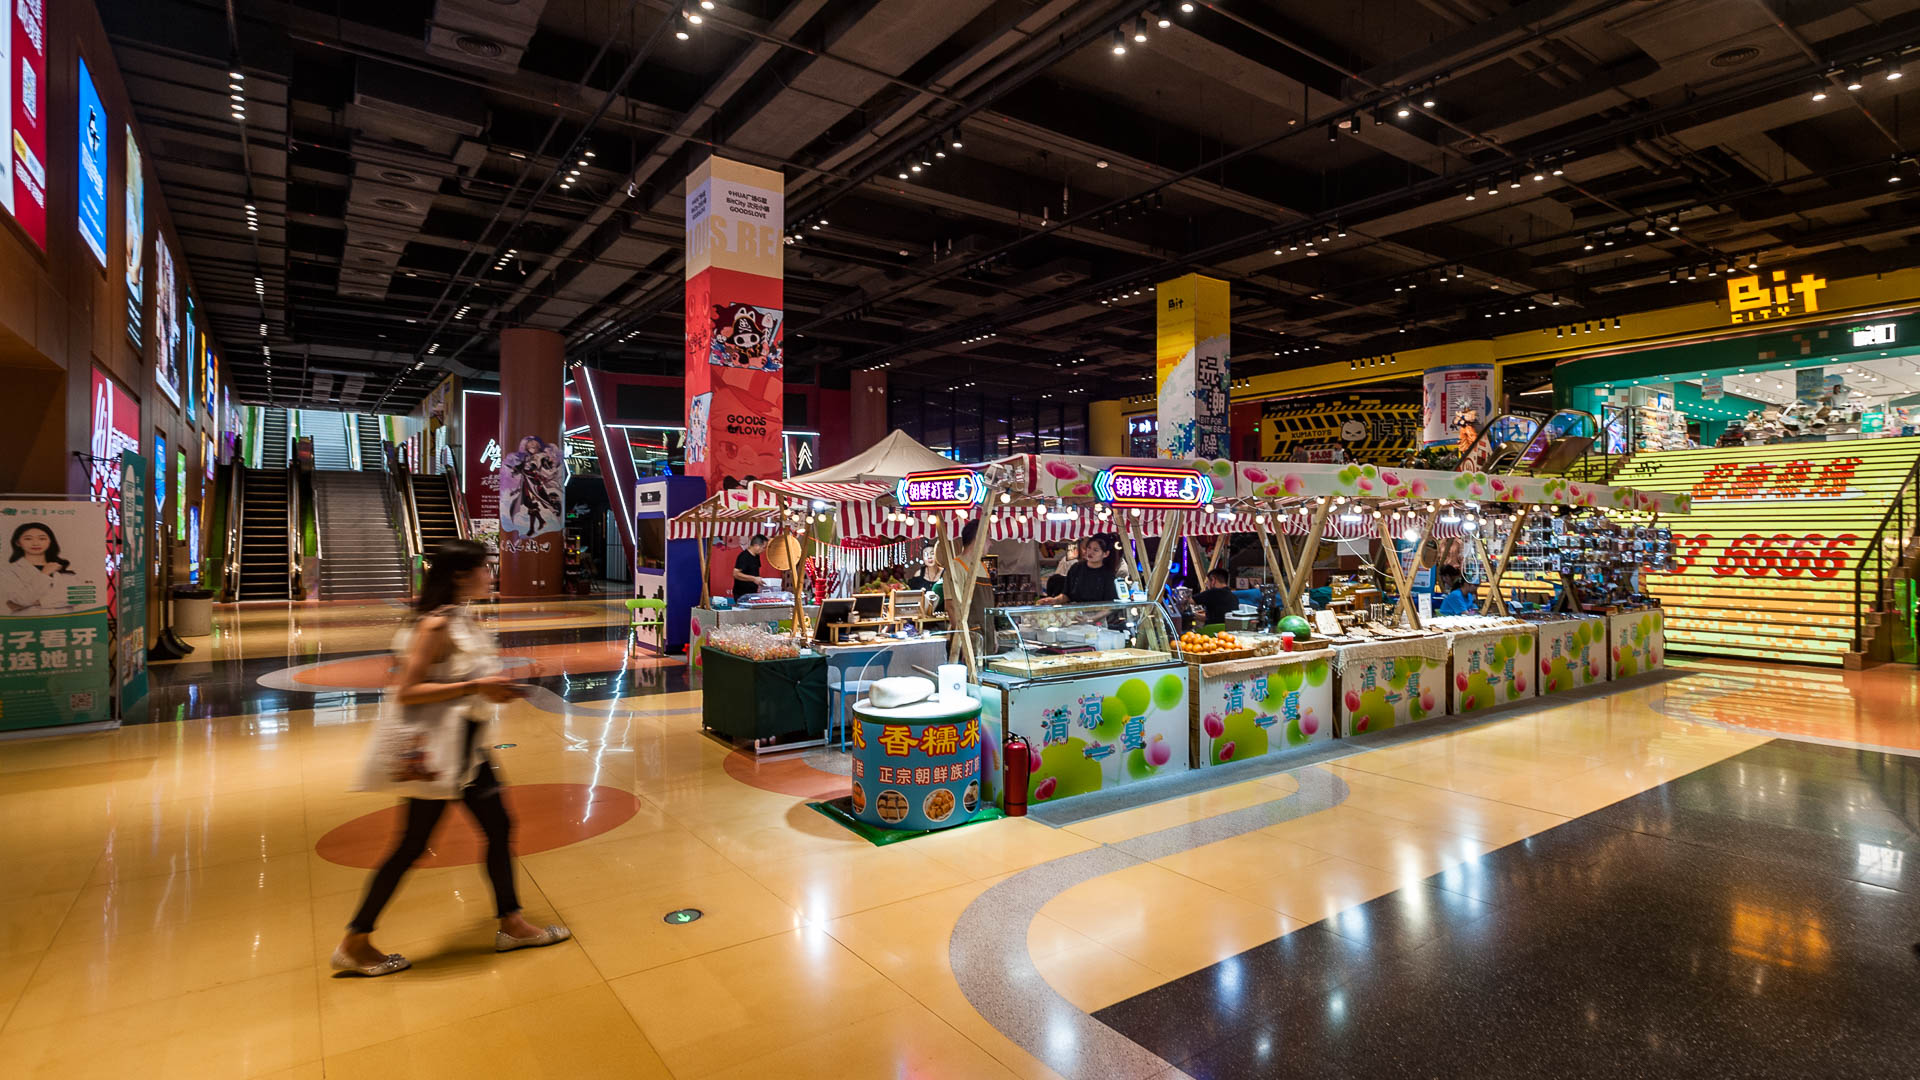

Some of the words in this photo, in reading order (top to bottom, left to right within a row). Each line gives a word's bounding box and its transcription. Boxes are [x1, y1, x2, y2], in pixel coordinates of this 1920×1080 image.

[729, 205, 767, 219] GOODSLOVE
[1727, 270, 1827, 313] Bit
[1731, 306, 1790, 324] CITY
[726, 413, 767, 427] GOODS
[908, 479, 955, 501] 朝鲜打糕
[1115, 476, 1179, 498] 朝鲜打糕
[0, 628, 98, 650] 子看牙
[879, 718, 980, 758] 香糯米
